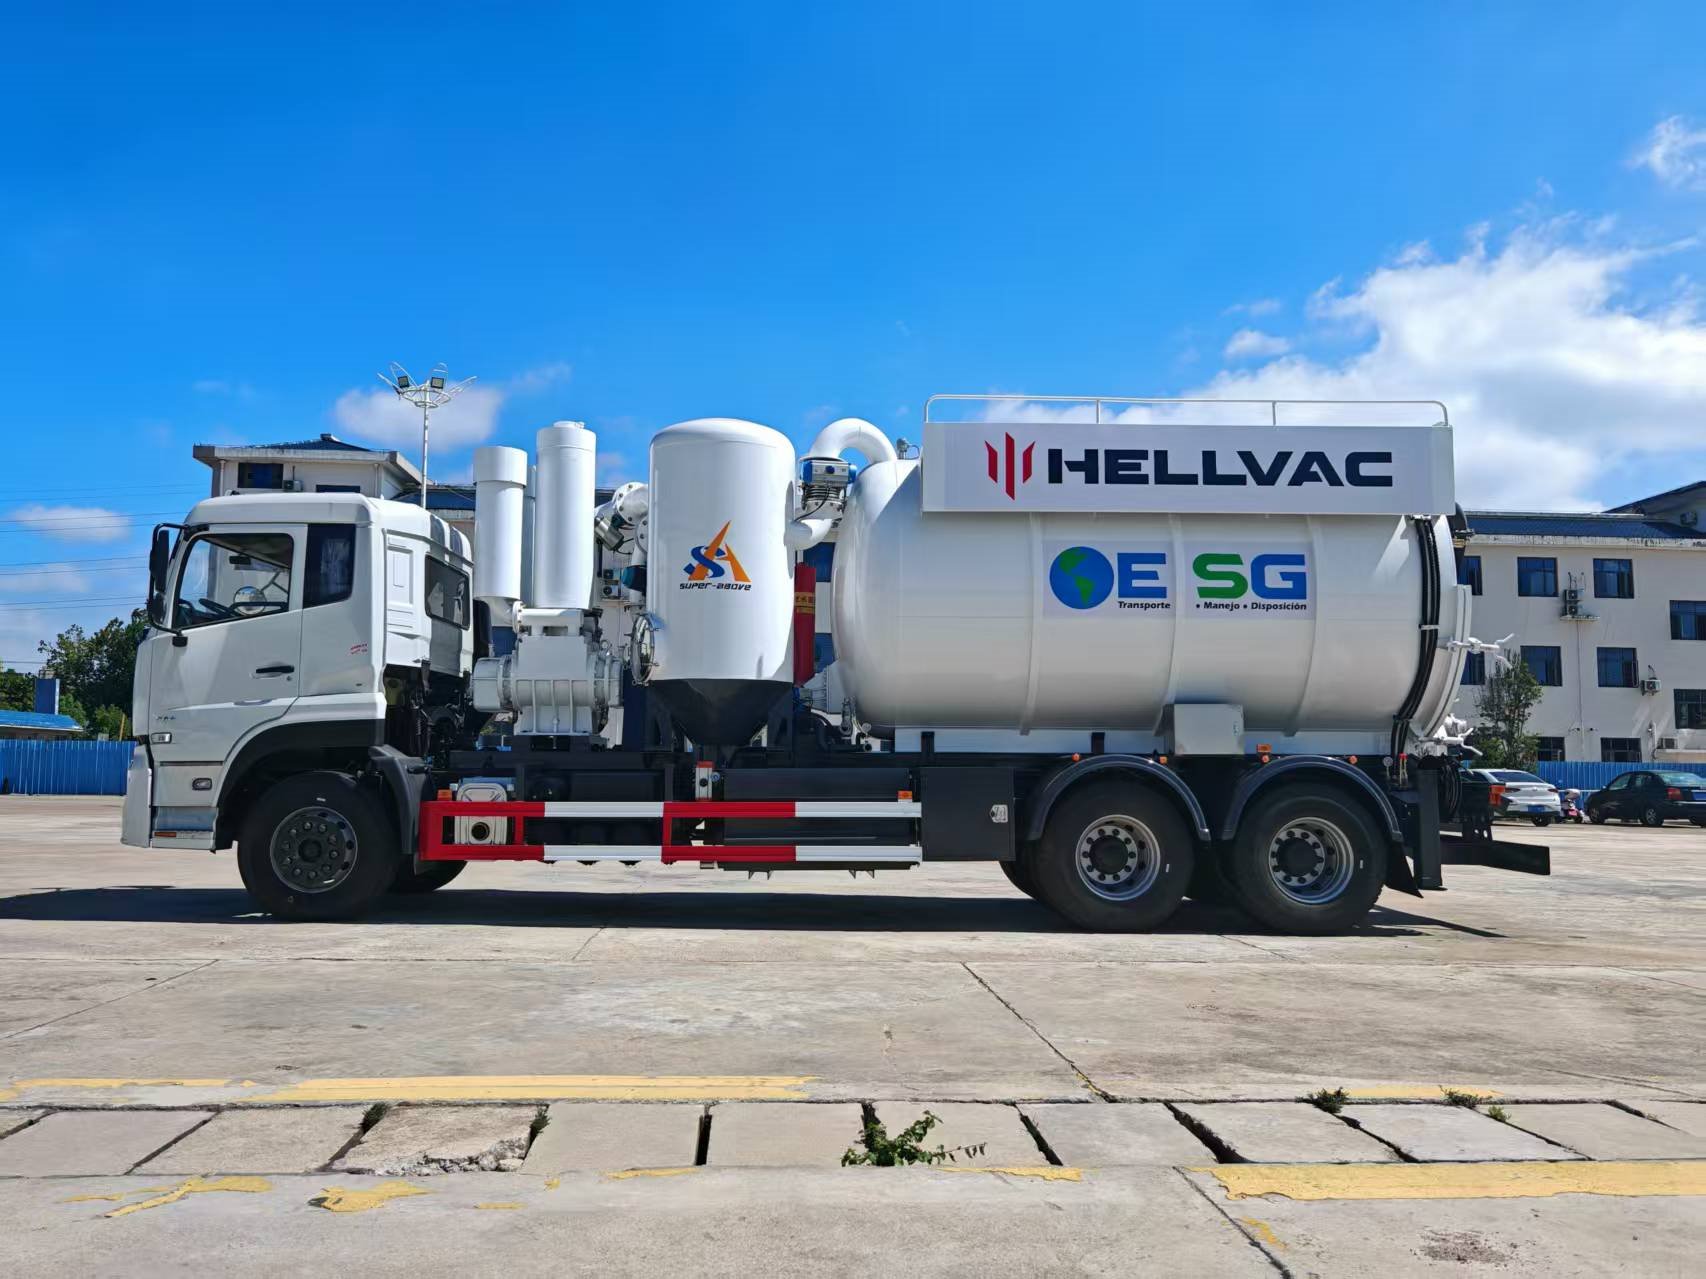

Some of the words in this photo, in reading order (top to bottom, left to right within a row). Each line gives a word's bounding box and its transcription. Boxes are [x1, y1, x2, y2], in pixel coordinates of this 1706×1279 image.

[1048, 448, 1393, 487] HELLVAC
[1118, 600, 1171, 611] Transporte
[1203, 601, 1240, 612] Manejo
[1251, 602, 1307, 612] Disposición
